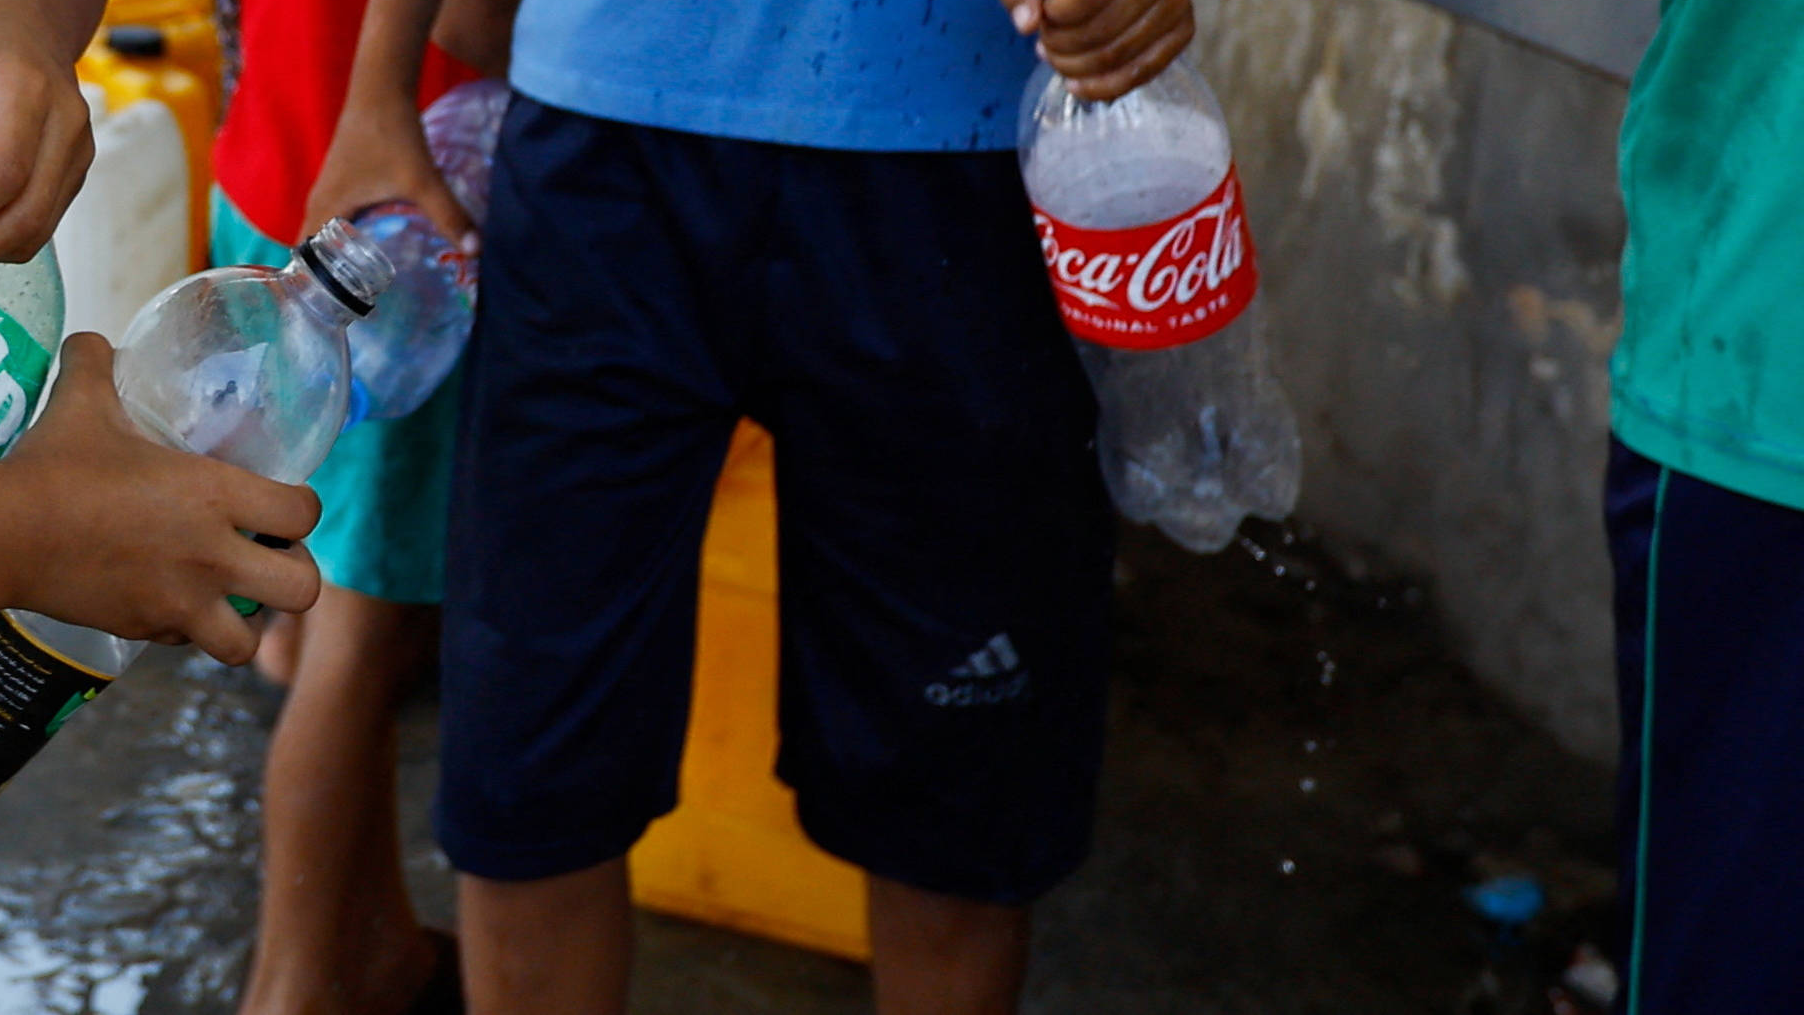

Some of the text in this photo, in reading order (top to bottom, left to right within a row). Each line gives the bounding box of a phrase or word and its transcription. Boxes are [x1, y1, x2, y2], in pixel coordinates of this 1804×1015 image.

[1033, 179, 1243, 312] oca-Cola
[1167, 293, 1229, 329] TASTE
[923, 669, 1033, 706] adid
